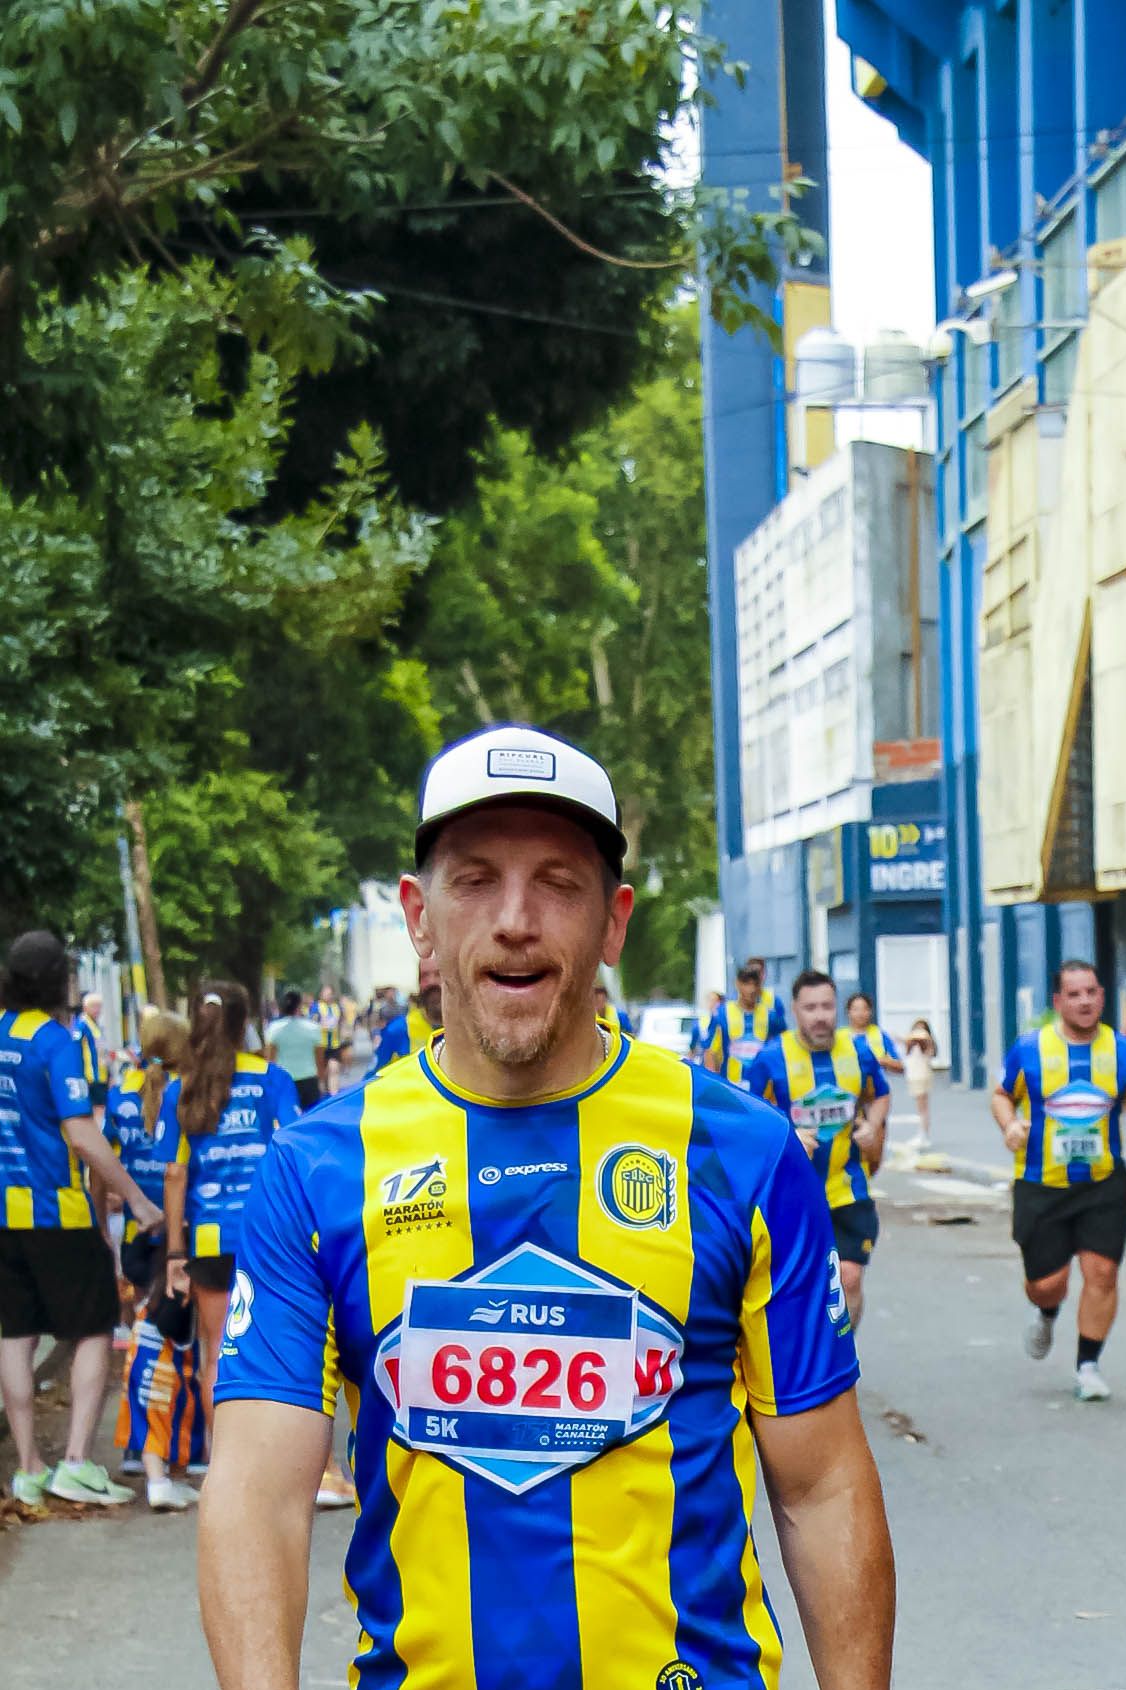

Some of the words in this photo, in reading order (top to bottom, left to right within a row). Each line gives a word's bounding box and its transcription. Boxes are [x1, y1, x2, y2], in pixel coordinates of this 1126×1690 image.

[504, 1161, 568, 1176] express
[383, 1200, 444, 1217] MARATÓN
[385, 1209, 446, 1225] CANALLA
[510, 1302, 566, 1327] RUS
[431, 1343, 608, 1412] 6826
[425, 1415, 460, 1440] 5K
[554, 1423, 609, 1433] MARATÓN
[555, 1431, 606, 1440] CANALLA
